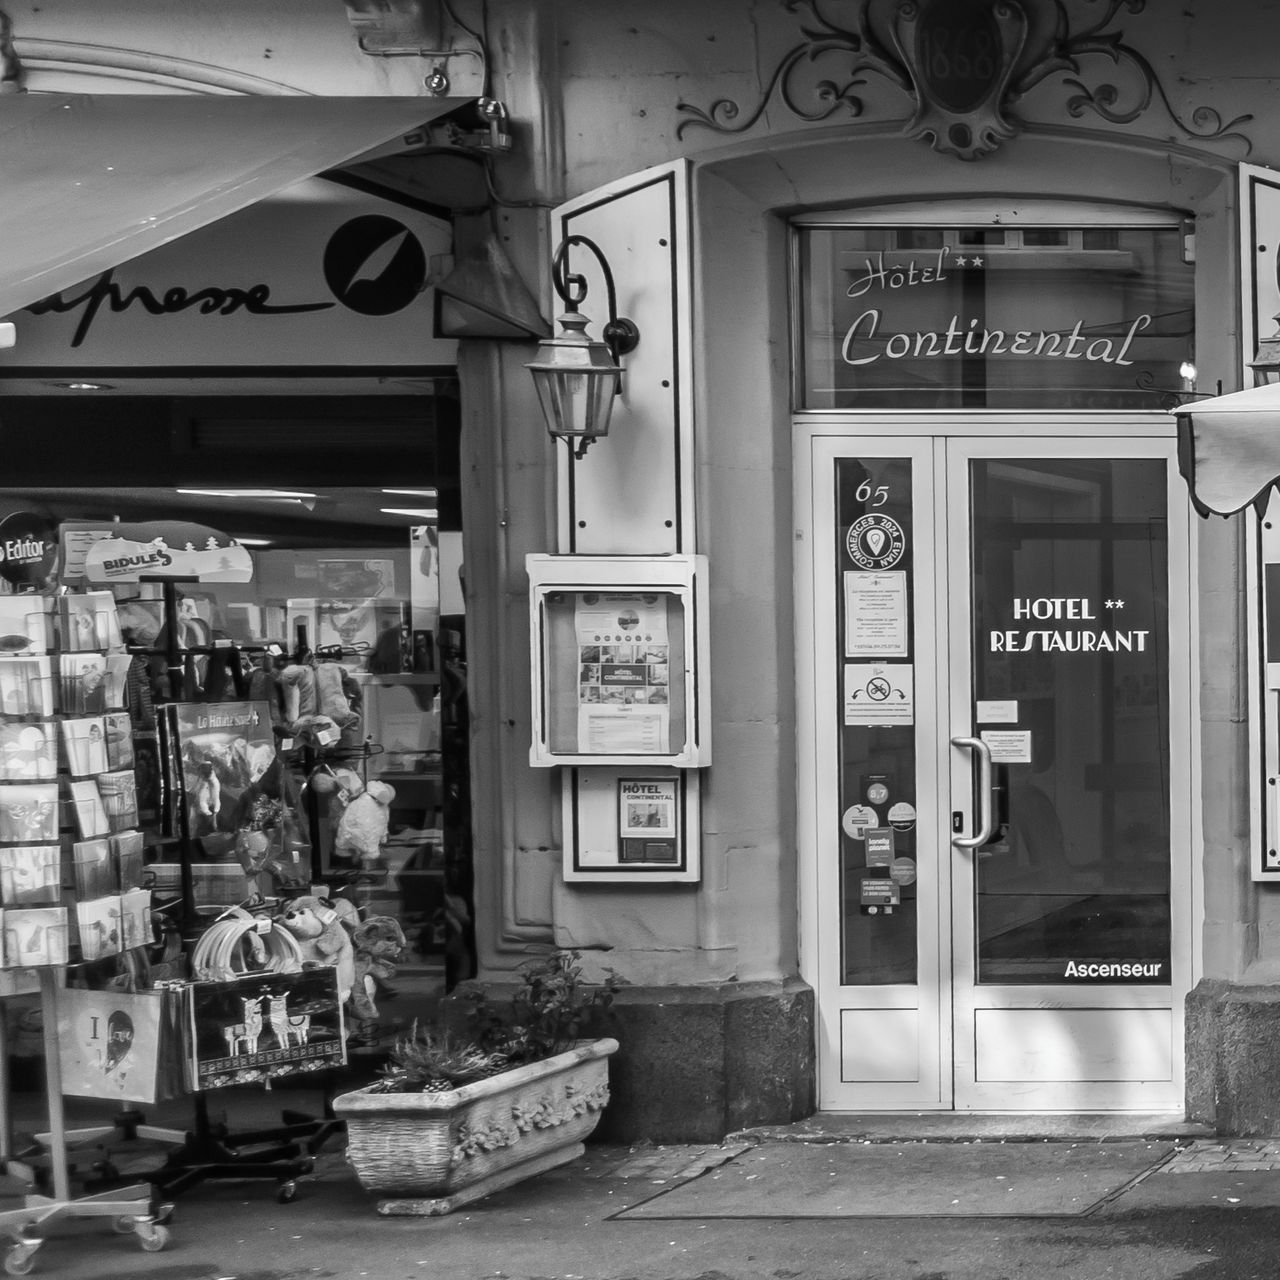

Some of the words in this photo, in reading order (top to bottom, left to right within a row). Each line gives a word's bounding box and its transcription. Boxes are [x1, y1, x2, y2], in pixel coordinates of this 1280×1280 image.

[847, 246, 952, 298] Hôtel
[841, 309, 1151, 367] Continental
[855, 478, 890, 507] 65
[879, 517, 901, 538] 2024
[5, 539, 45, 562] Editor
[849, 516, 876, 568] COMMERCES
[102, 549, 173, 571] BIDULES
[879, 541, 902, 568] EVIAN
[1013, 598, 1096, 620] HOTEL
[990, 630, 1150, 652] RESTAURANT
[622, 782, 662, 795] HÔTEL
[870, 789, 886, 799] 8,7
[1064, 960, 1162, 978] Ascenseur
